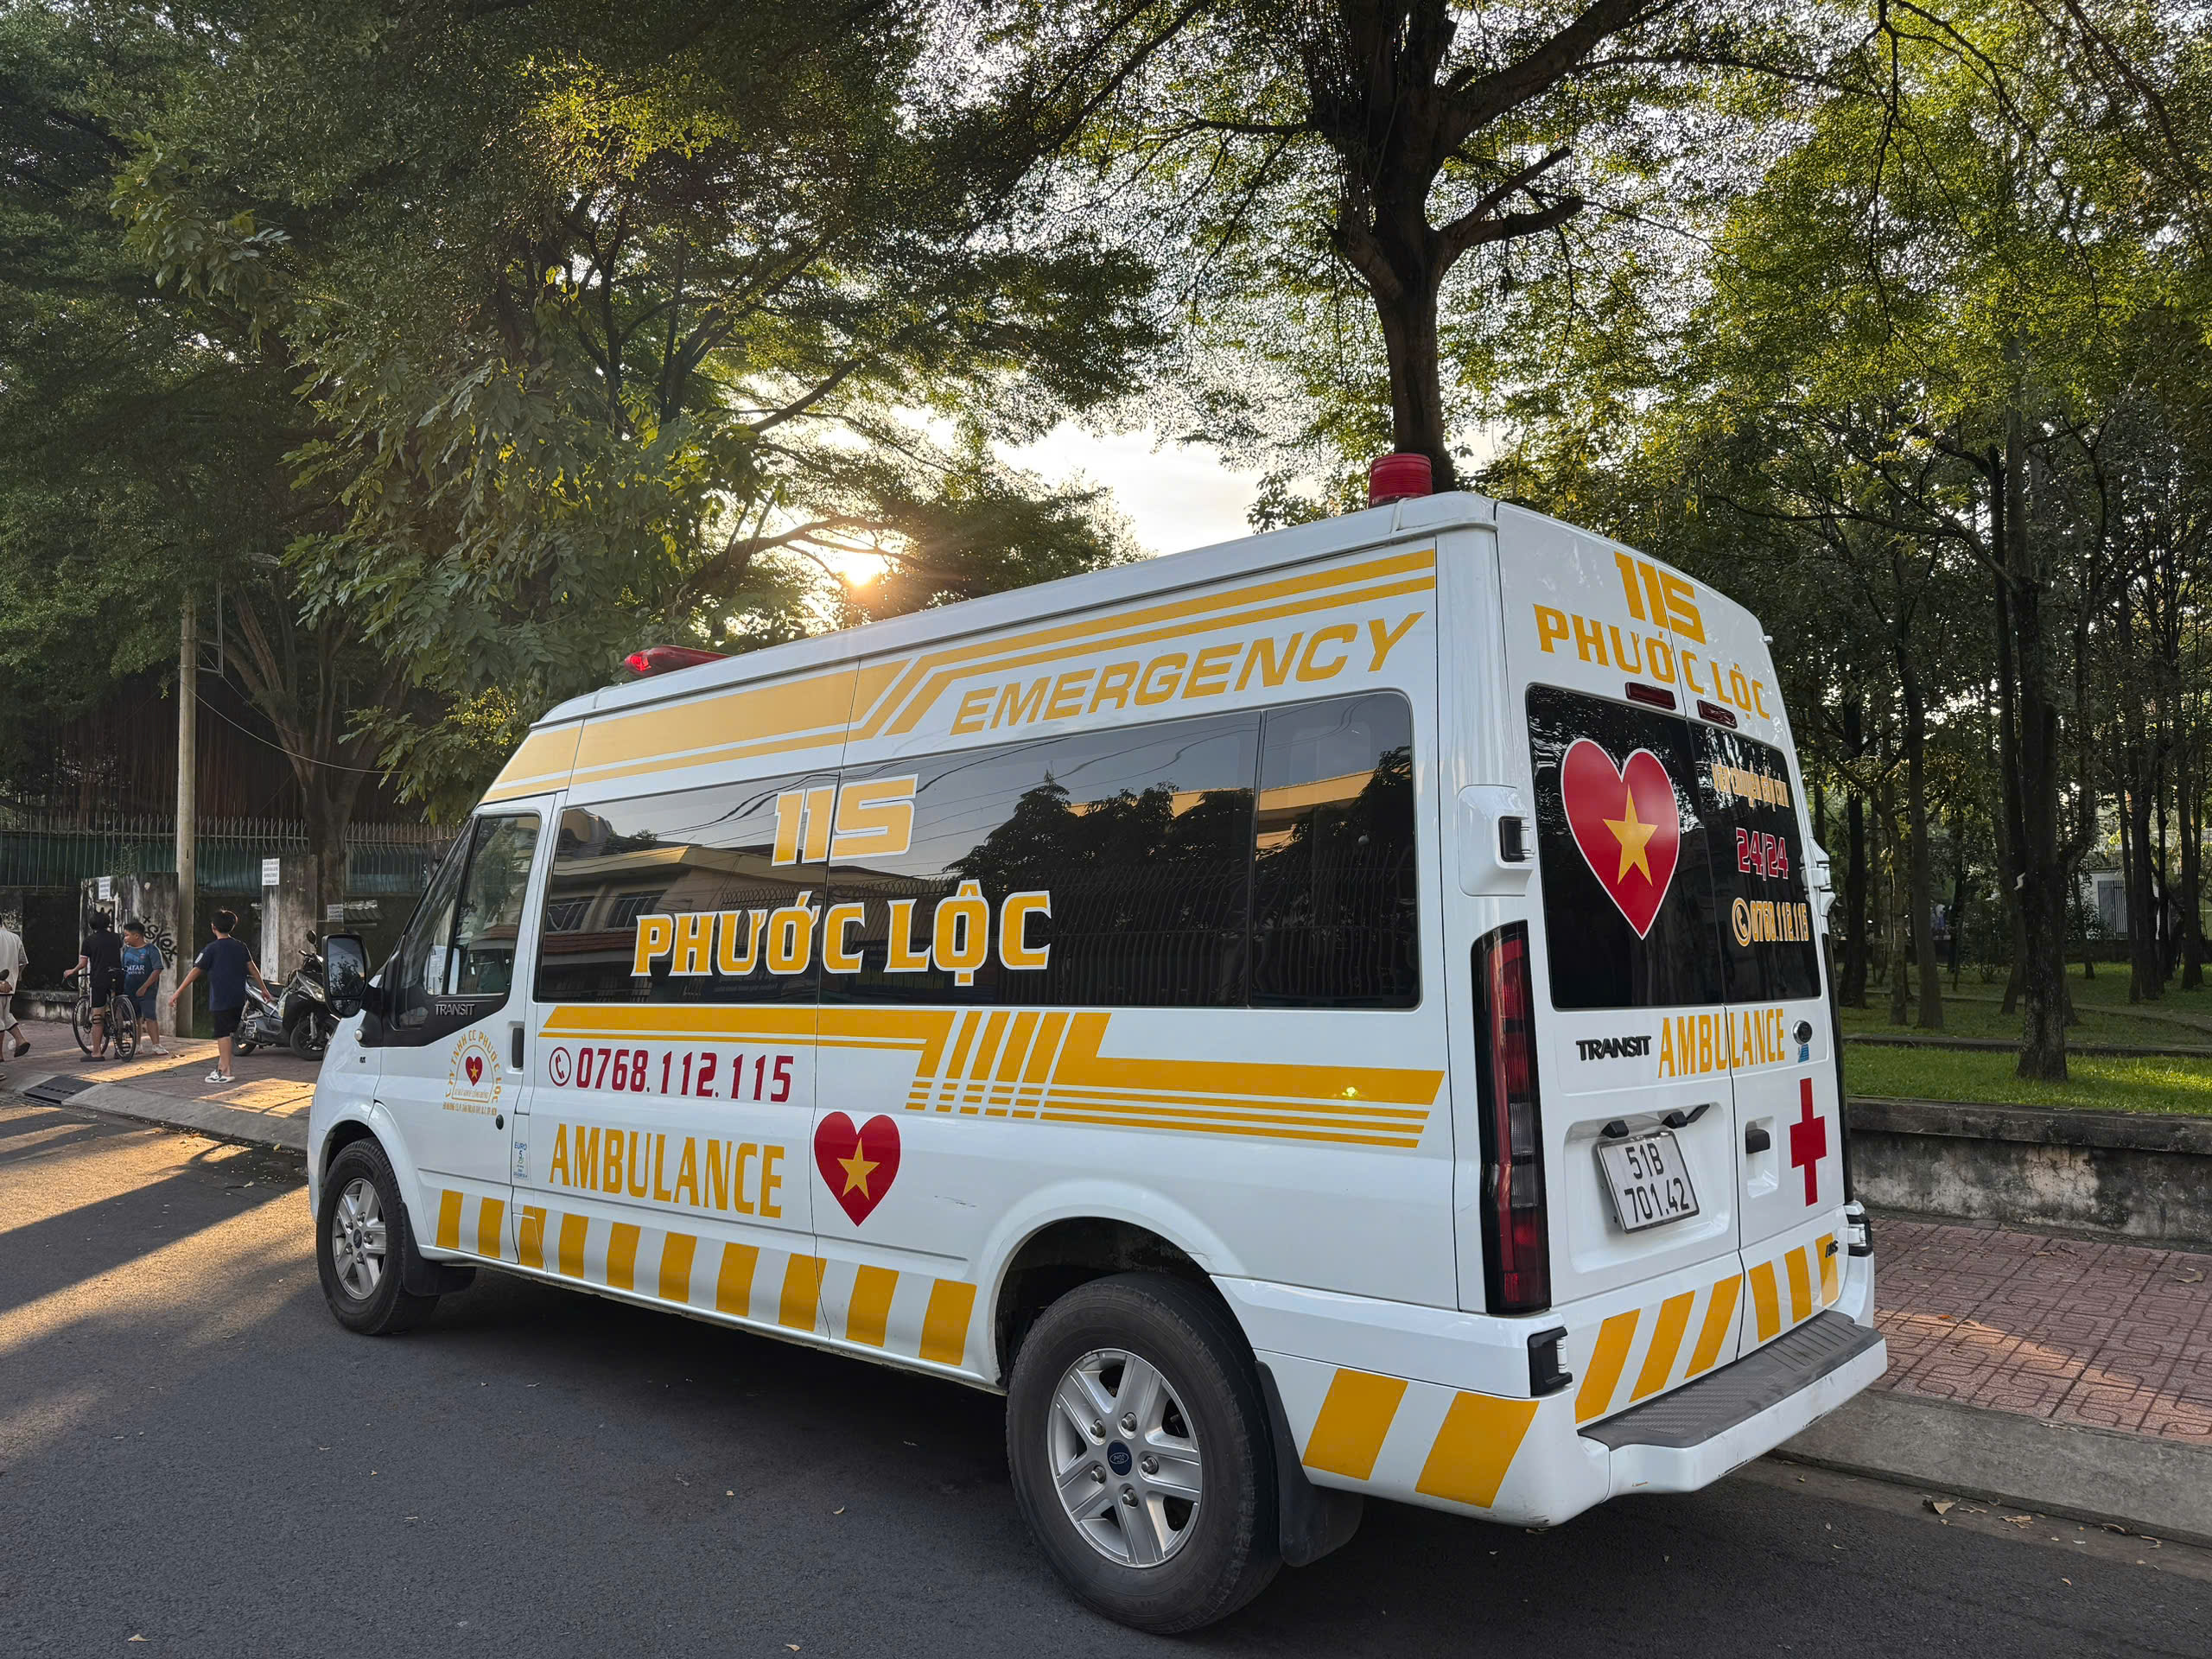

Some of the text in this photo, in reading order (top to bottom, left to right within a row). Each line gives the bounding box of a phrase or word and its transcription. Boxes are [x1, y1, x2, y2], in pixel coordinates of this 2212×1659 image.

[1614, 551, 1707, 645] 115
[950, 611, 1427, 735] EMERGENCY
[1533, 603, 1770, 720] PHƯỚC LỘC
[772, 773, 918, 866] 115
[1736, 827, 1789, 881] 24/24
[630, 879, 1052, 987] PHƯỚC LỘC
[435, 1003, 475, 1016] TRANSIT
[1575, 1035, 1651, 1062] TRANSIT
[1658, 1008, 1785, 1078] AMBULANCE
[576, 1047, 794, 1103] 0768.112.115
[514, 1141, 527, 1150] EURO
[549, 1123, 785, 1219] AMBULANCE
[1624, 1142, 1664, 1179] 51B
[1624, 1178, 1690, 1224] 701.42
